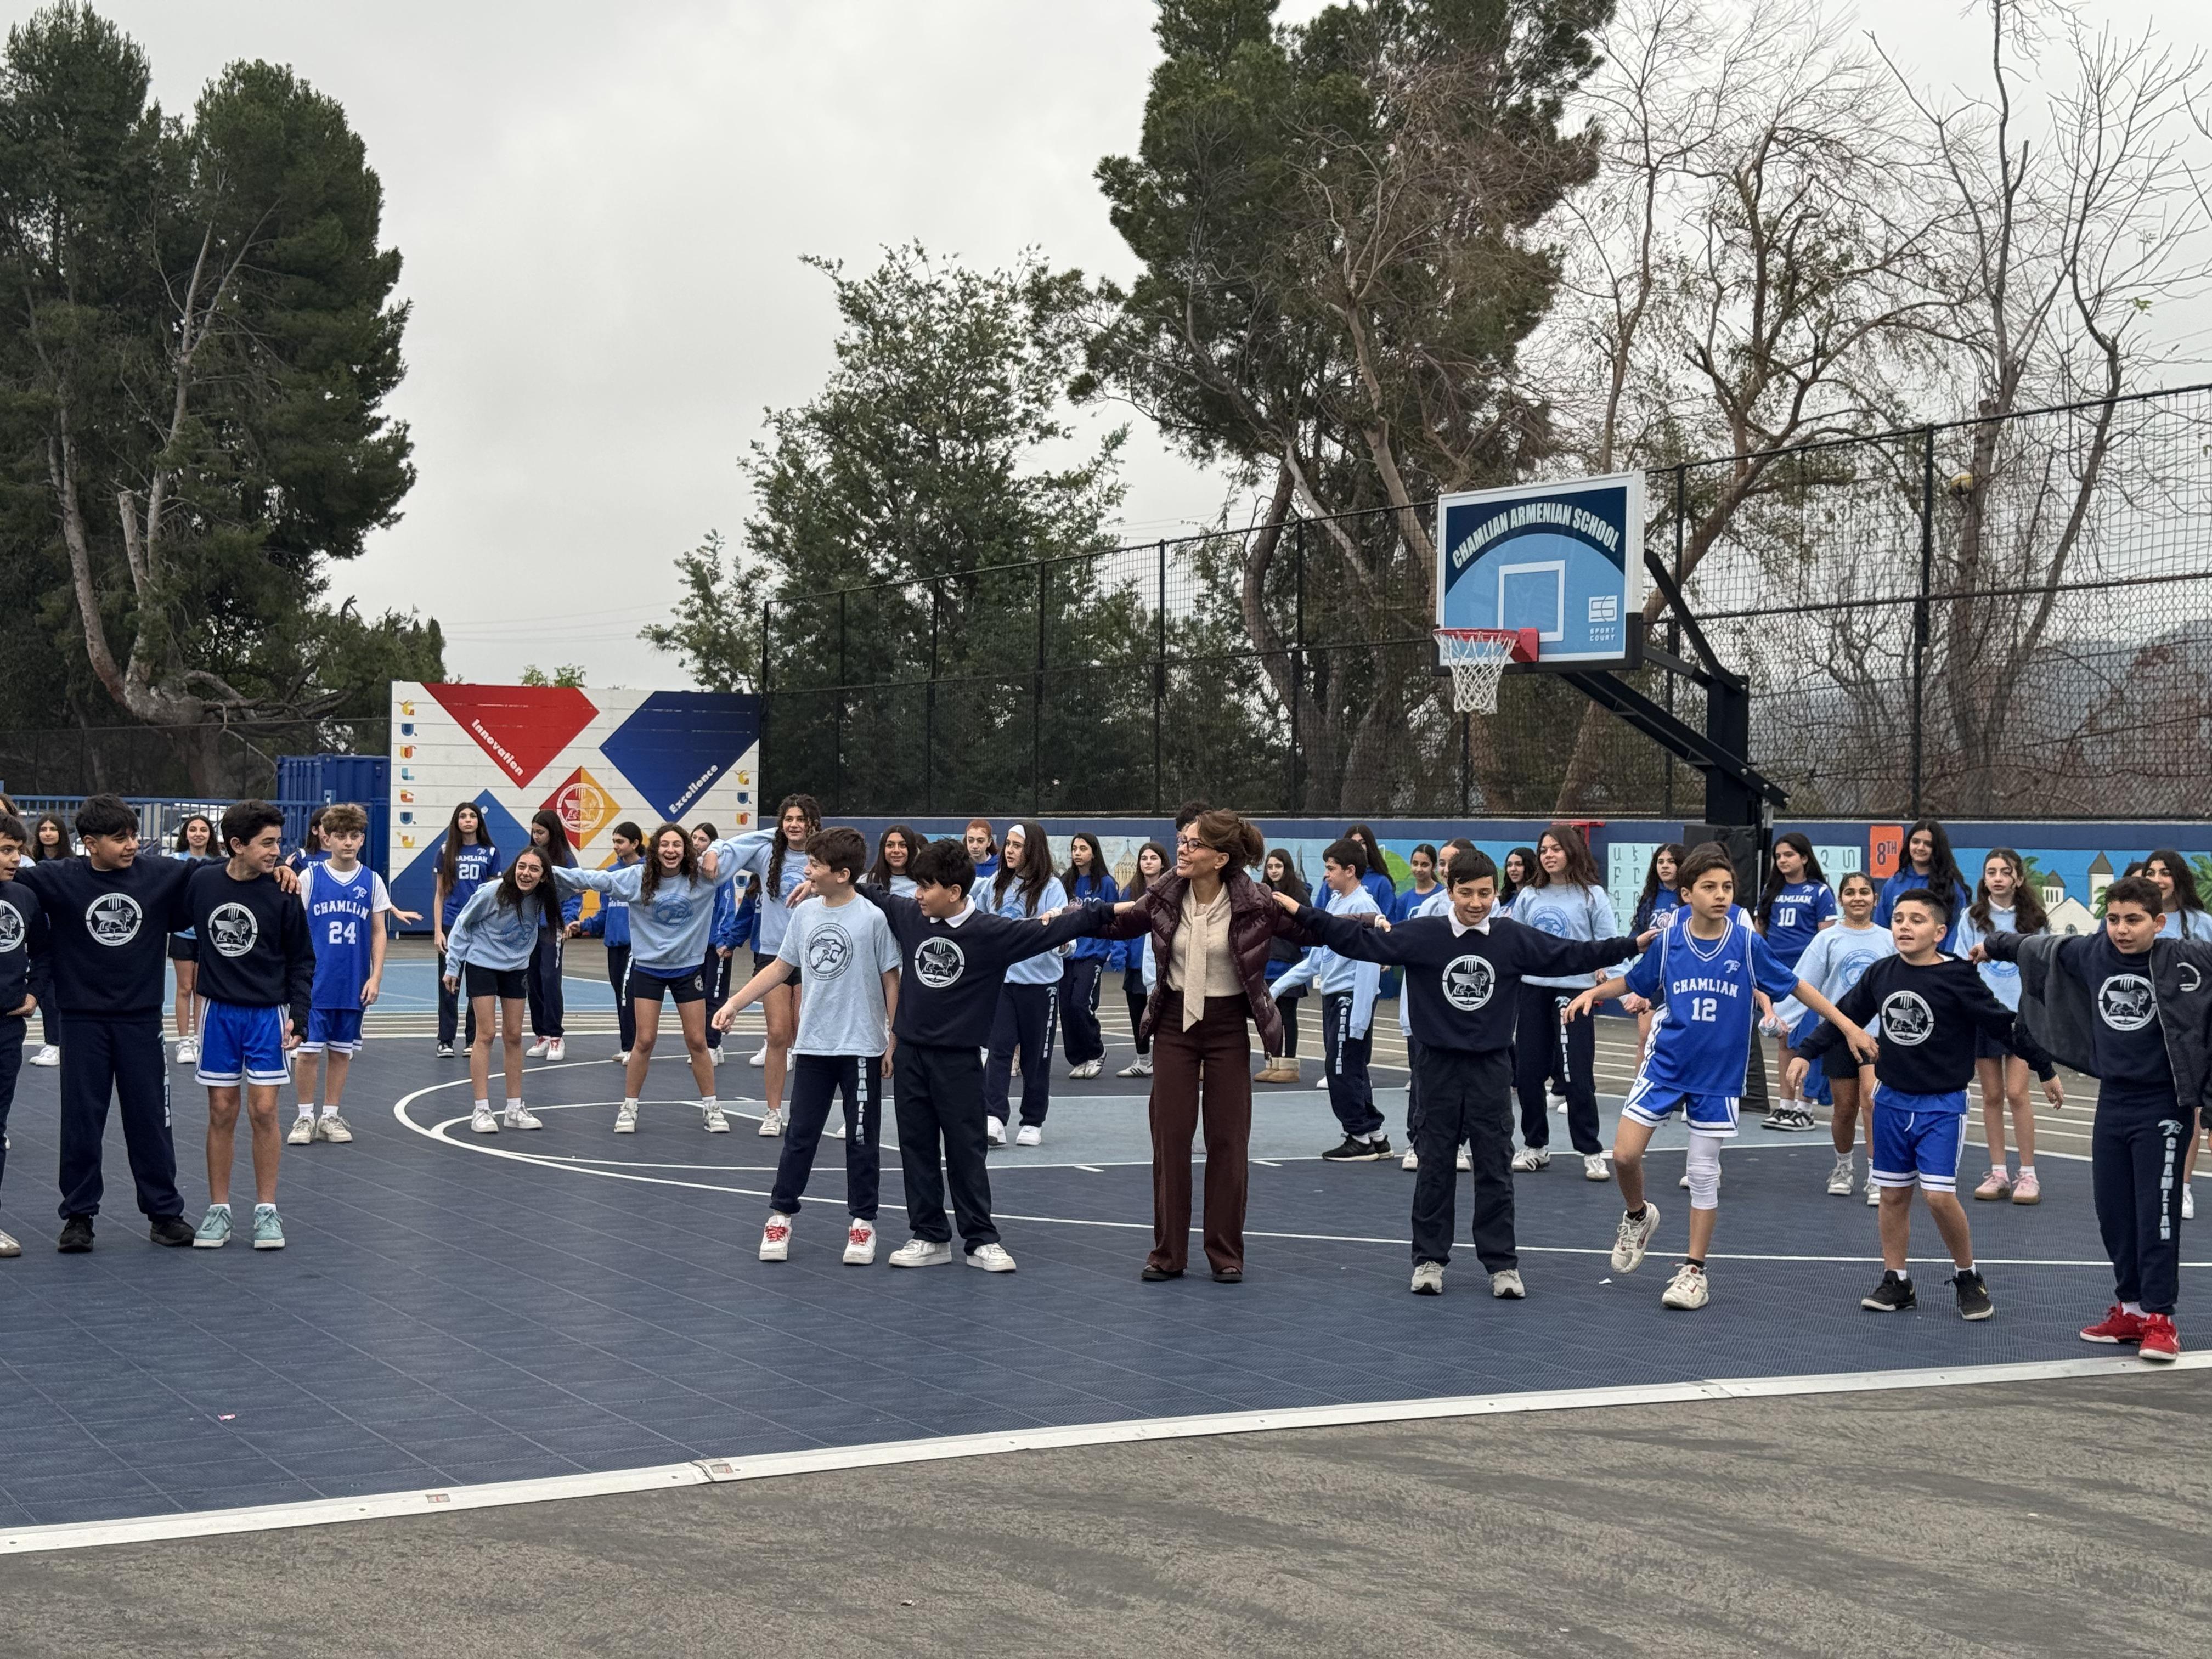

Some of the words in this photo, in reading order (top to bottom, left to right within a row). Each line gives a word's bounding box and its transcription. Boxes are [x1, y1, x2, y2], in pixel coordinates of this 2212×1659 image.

[1452, 512, 1509, 569] CHAMLIAN
[1510, 503, 1572, 529] ARMENIAN
[1573, 507, 1620, 553] SCHOOL
[472, 719, 524, 777] Innovation
[669, 765, 718, 815] Excellence
[455, 855, 488, 864] AMLIAN
[1877, 840, 1897, 866] 8TH
[459, 863, 480, 881] 20
[1774, 895, 1813, 905] AMLIAN
[1778, 907, 1797, 927] 10
[329, 921, 357, 945] 24
[1673, 978, 1739, 998] CHAMLIAN
[1691, 997, 1718, 1022] 12
